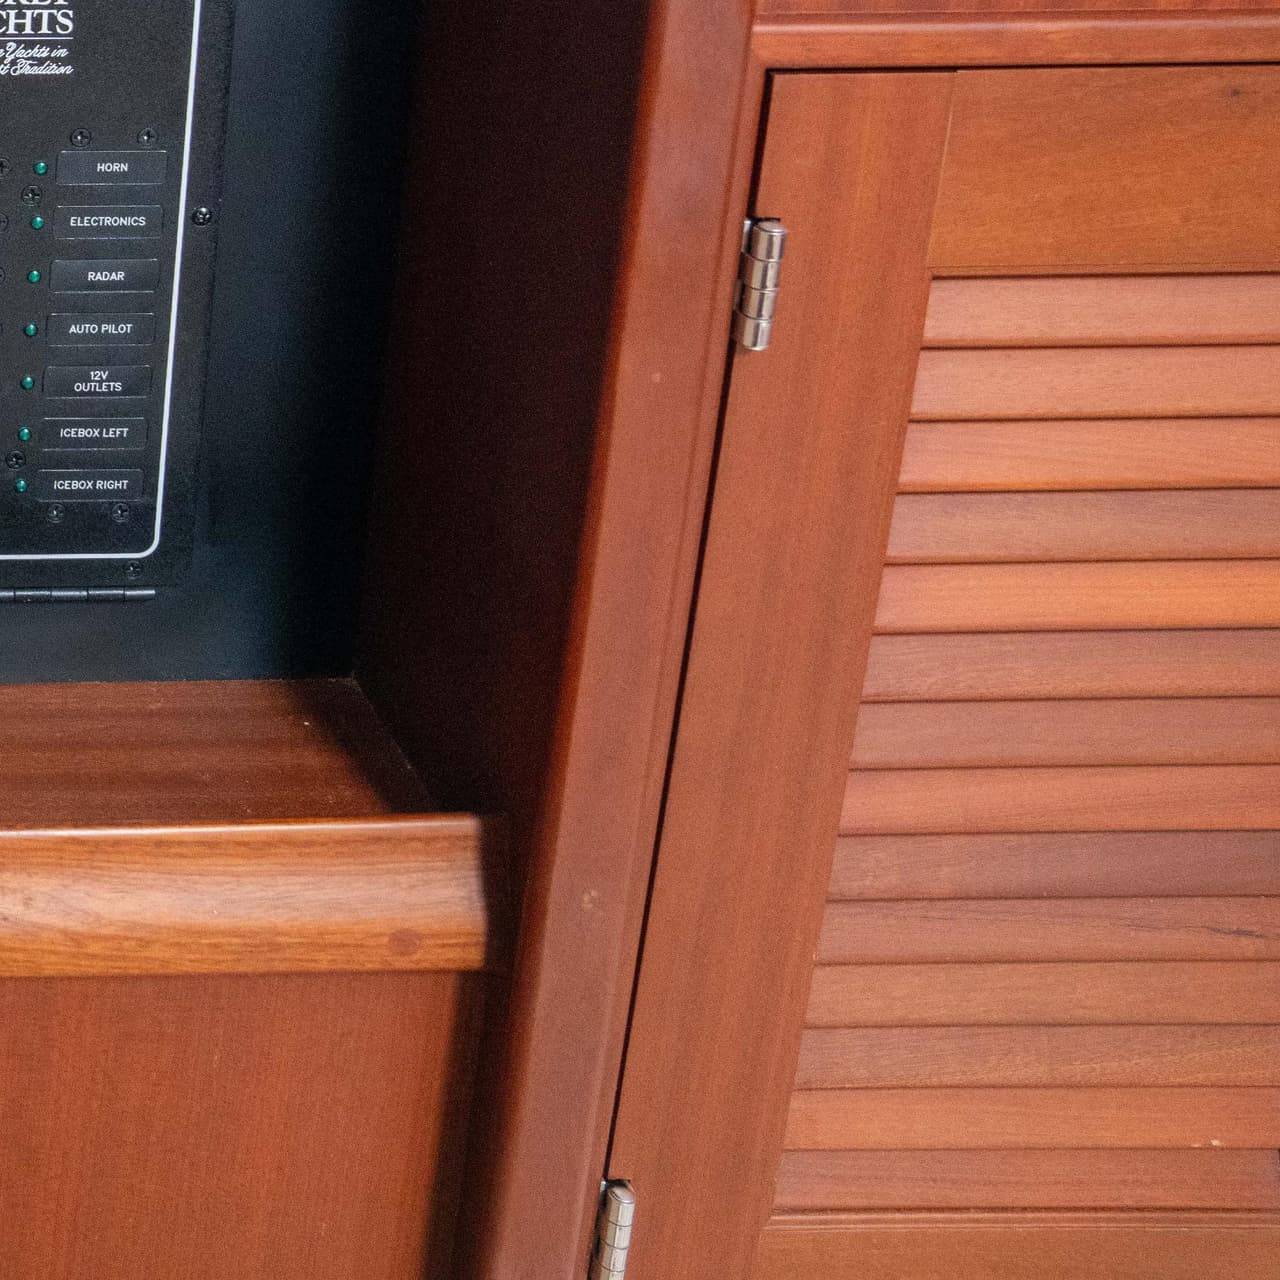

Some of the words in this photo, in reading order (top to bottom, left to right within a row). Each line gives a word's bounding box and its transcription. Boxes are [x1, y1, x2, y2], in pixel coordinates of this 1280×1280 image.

[4, 42, 50, 63] Yachts
[52, 45, 68, 58] in
[11, 59, 74, 75] Tradition
[97, 163, 128, 172] HORN
[70, 217, 146, 226] ELECTRONICS
[88, 272, 124, 281] RADAR
[69, 324, 98, 334] AUTO
[101, 324, 132, 334] PILOT
[90, 371, 108, 381] 12V
[74, 382, 122, 392] OUTLETS
[60, 428, 99, 438] ICEBOX
[103, 428, 128, 438] LEFT
[54, 480, 93, 490] ICEBOX
[96, 480, 128, 490] RIGHT
